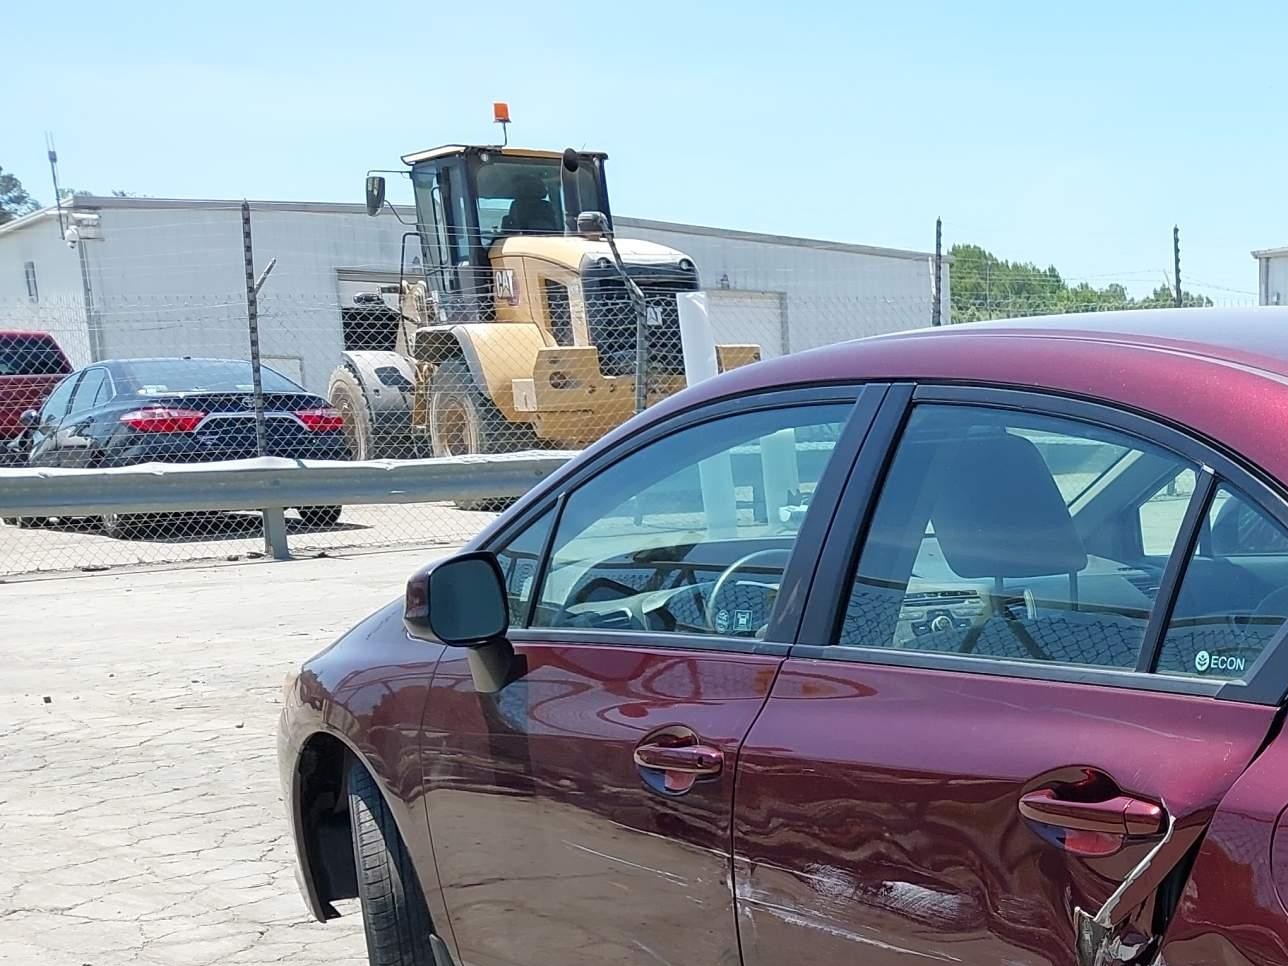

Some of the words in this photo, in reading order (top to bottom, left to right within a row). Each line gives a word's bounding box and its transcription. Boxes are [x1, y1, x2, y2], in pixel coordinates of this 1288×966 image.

[496, 270, 514, 298] CAT
[645, 305, 663, 326] AT
[1210, 655, 1245, 671] ECON
